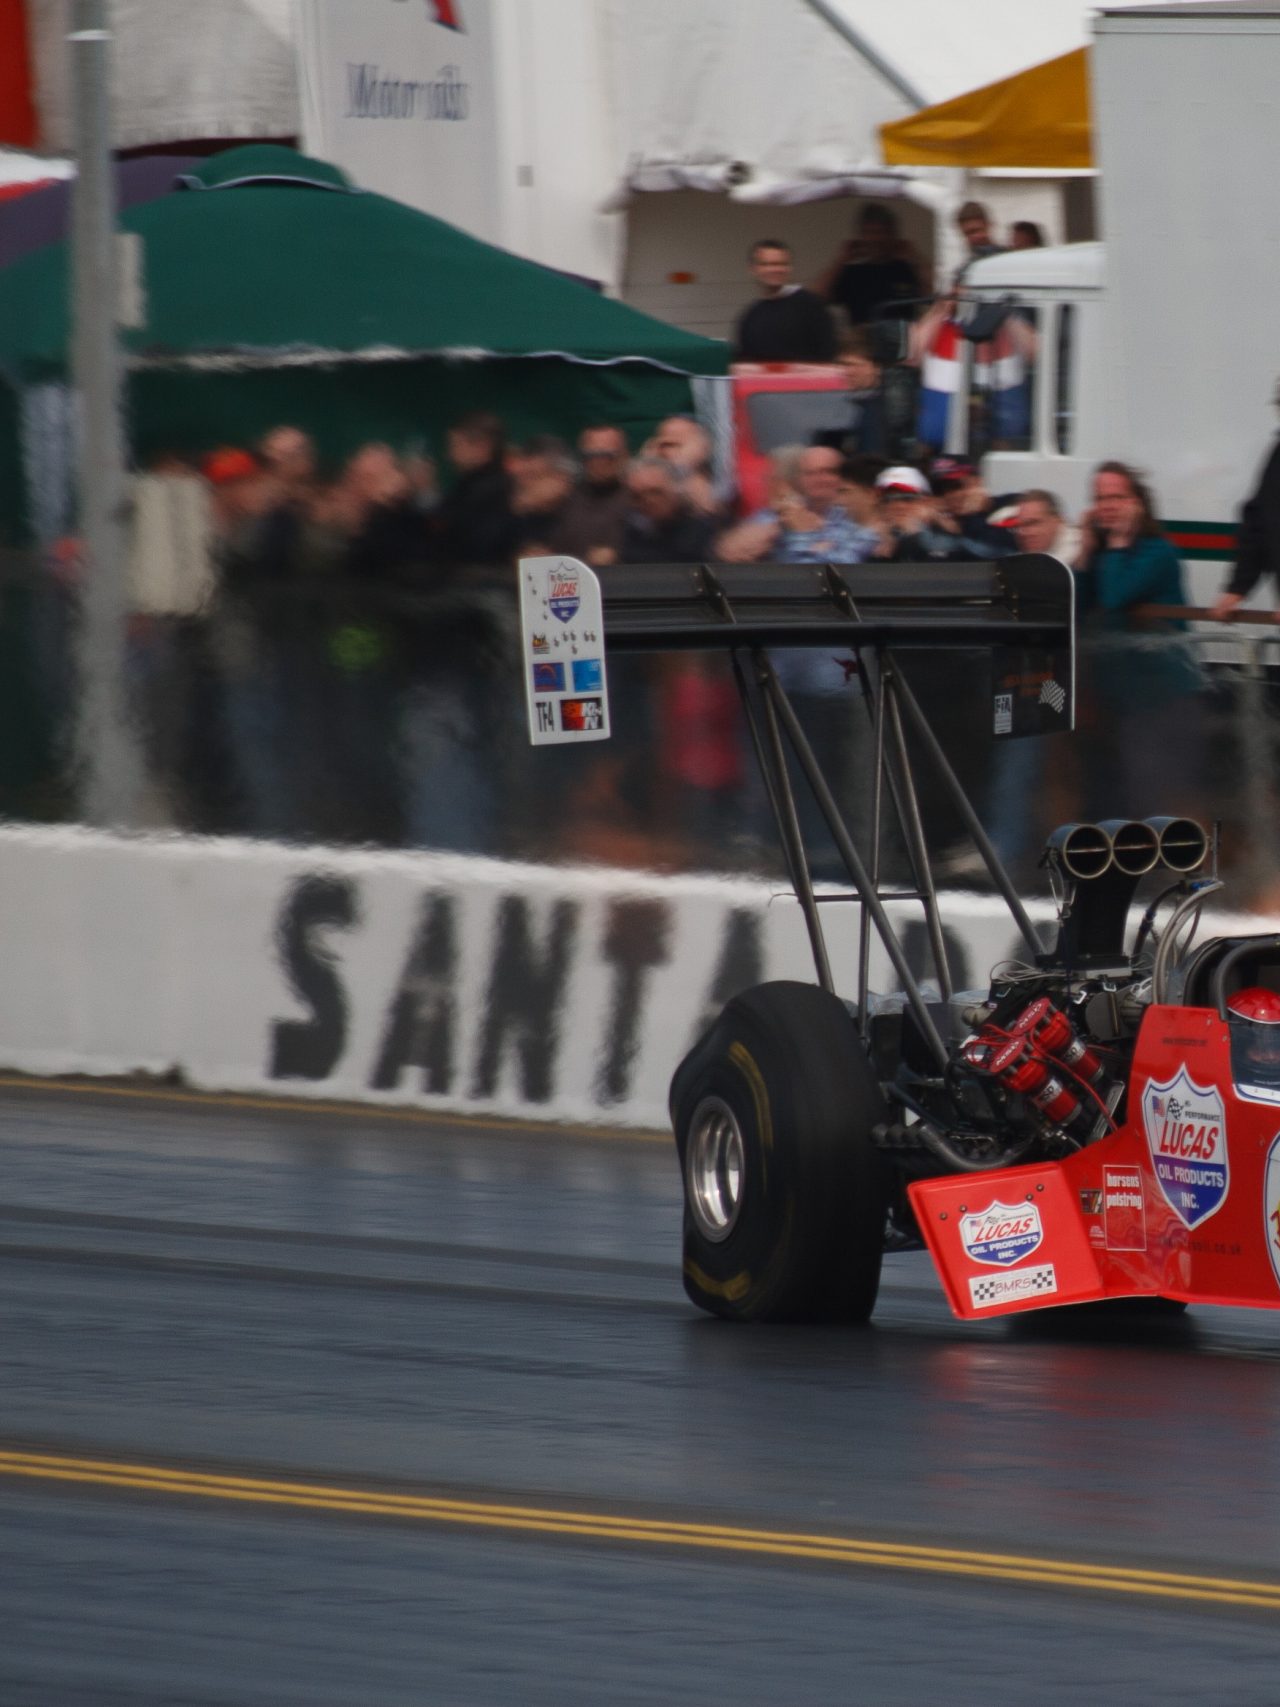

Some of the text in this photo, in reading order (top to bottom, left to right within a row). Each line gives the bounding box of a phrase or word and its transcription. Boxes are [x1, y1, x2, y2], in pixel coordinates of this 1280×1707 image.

[266, 873, 768, 1108] SANTA
[1159, 1120, 1219, 1161] LUCAS
[1157, 1163, 1224, 1188] OIL PRODUCTS
[1181, 1191, 1200, 1209] INC.
[974, 1217, 1034, 1243] LUCAS
[970, 1234, 1039, 1255] OIL PRODUCTS
[994, 1277, 1032, 1294] BMRS
